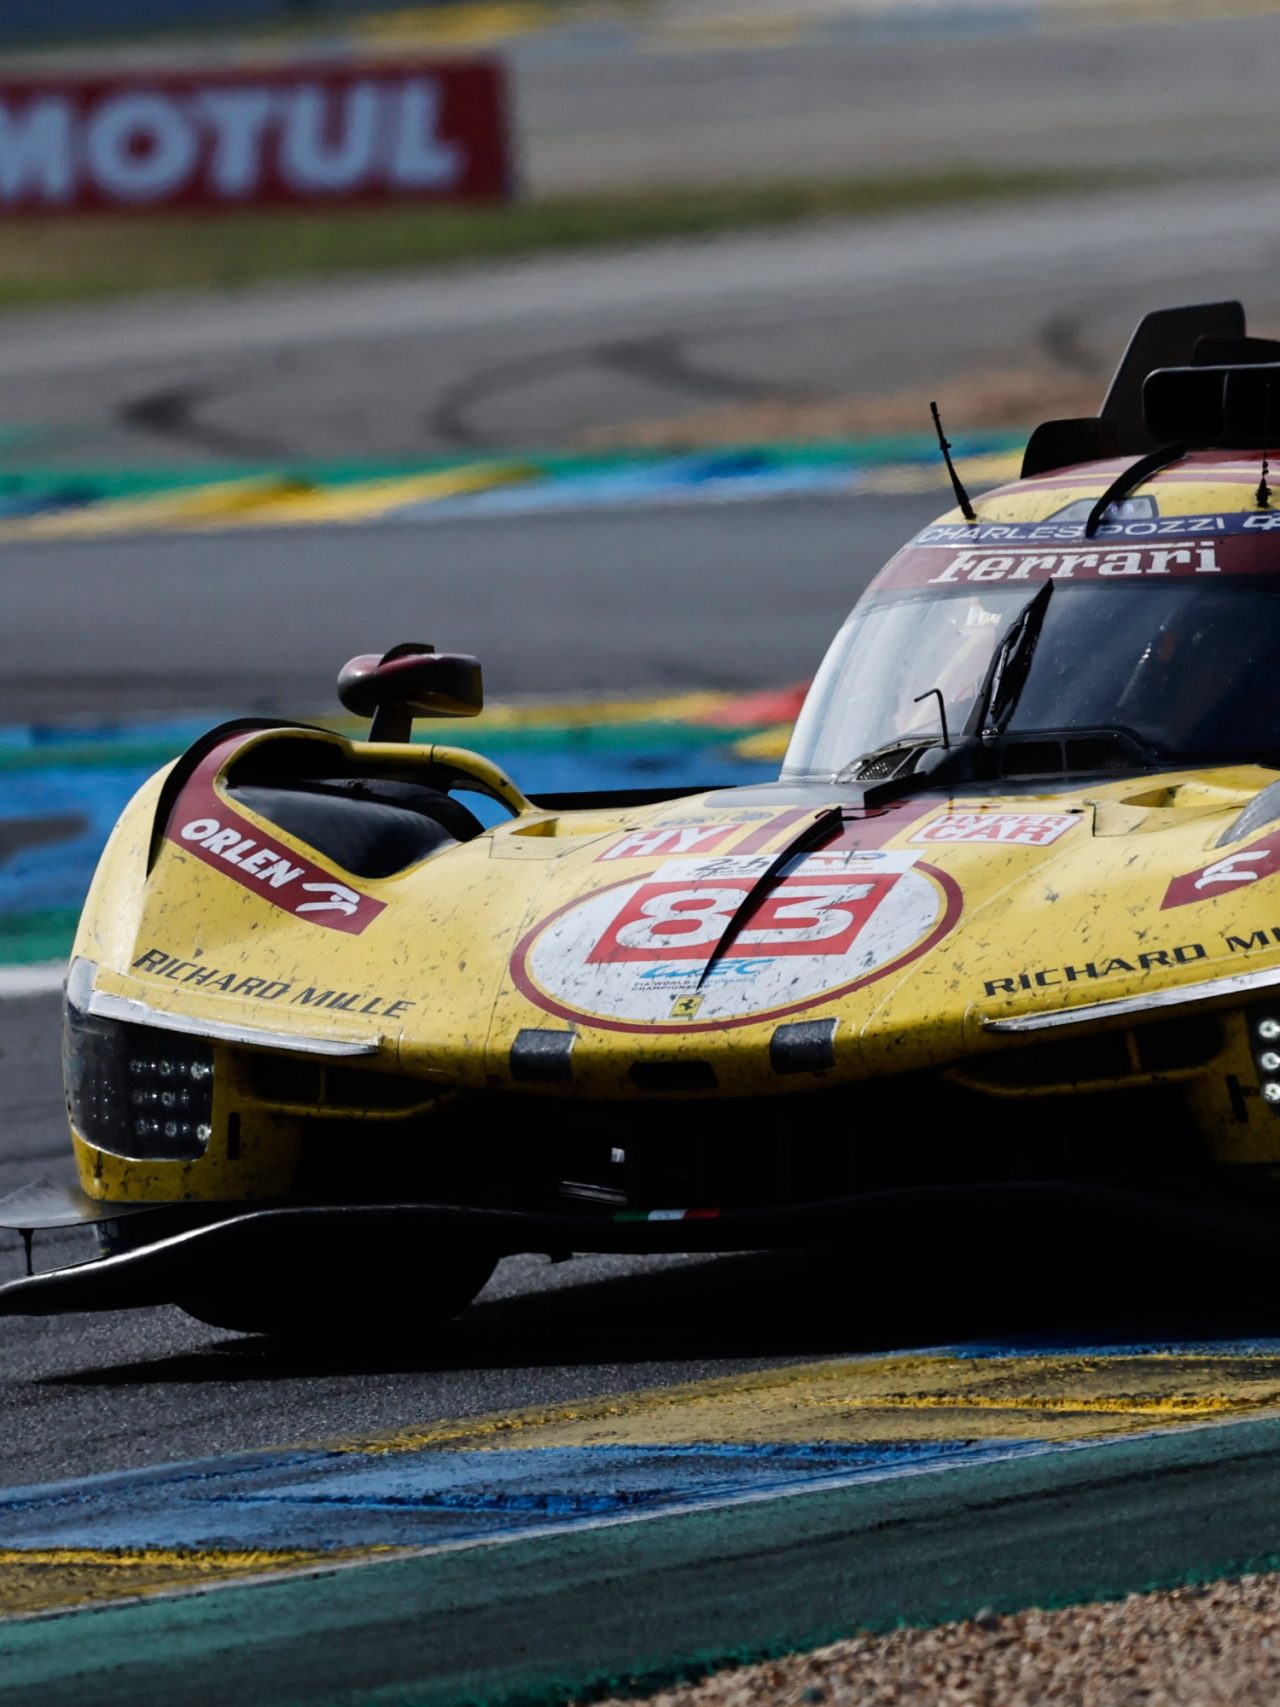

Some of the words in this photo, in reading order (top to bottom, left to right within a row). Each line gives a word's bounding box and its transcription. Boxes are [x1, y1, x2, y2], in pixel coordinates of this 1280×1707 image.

[0, 77, 466, 206] MOTUL
[917, 525, 1087, 543] CHARLES
[927, 541, 1222, 584] Ferrari
[600, 824, 737, 860] HY
[923, 825, 1054, 842] CAR
[938, 815, 1069, 826] HYPER
[180, 817, 306, 888] ORLEN
[616, 882, 874, 950] 83
[131, 948, 291, 1000] RICHARD
[291, 986, 416, 1020] MILLE
[692, 977, 756, 985] EDURANCE
[983, 942, 1207, 997] RICHARD
